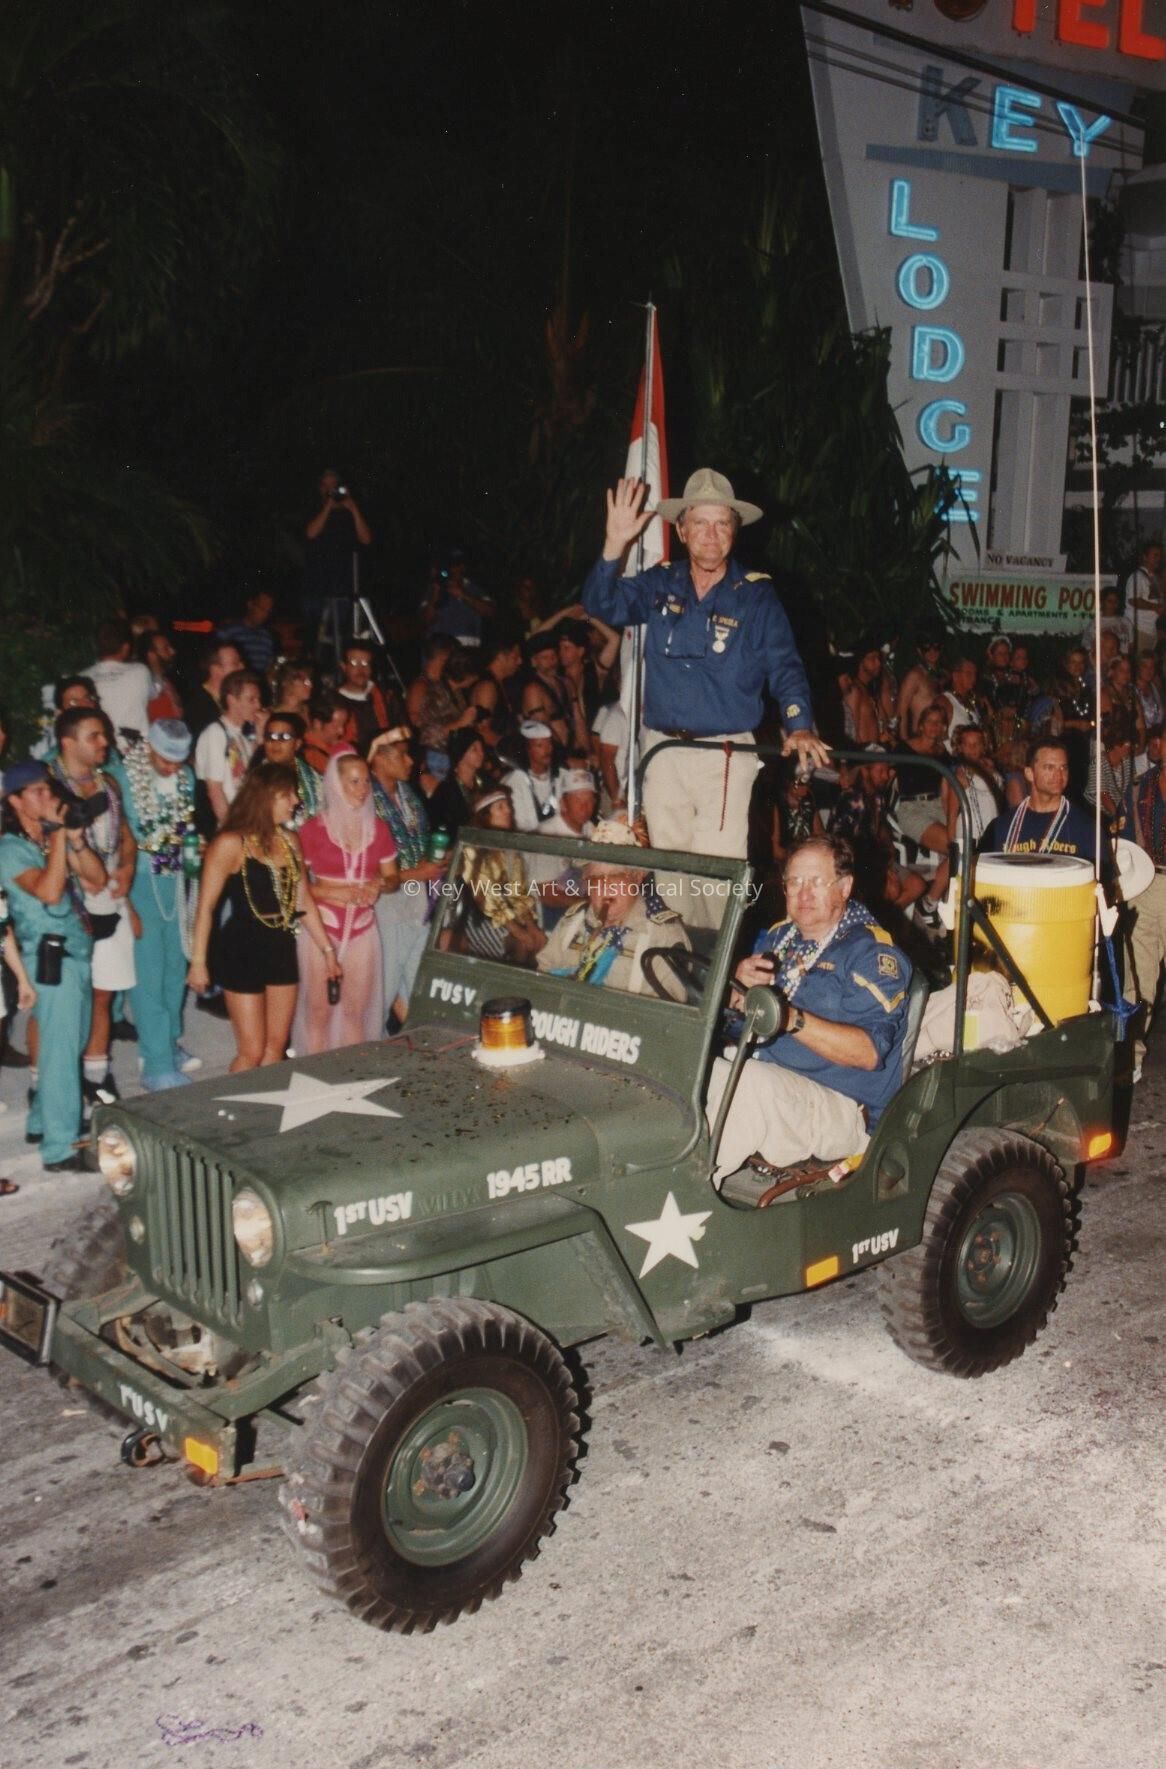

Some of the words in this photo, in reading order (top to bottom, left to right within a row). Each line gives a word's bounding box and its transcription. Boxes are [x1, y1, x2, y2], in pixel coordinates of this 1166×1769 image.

[916, 64, 1112, 157] KEY
[888, 177, 981, 522] LODGE
[986, 553, 1003, 565] NO
[1005, 554, 1055, 568] VACANCY
[949, 581, 1048, 609] SWIMMING
[1058, 586, 1097, 612] POO
[1008, 610, 1069, 619] APARTMENTS
[580, 1022, 642, 1065] RIDERS
[486, 1163, 542, 1199] 1945
[541, 1156, 573, 1188] RR
[368, 1190, 413, 1226] USV
